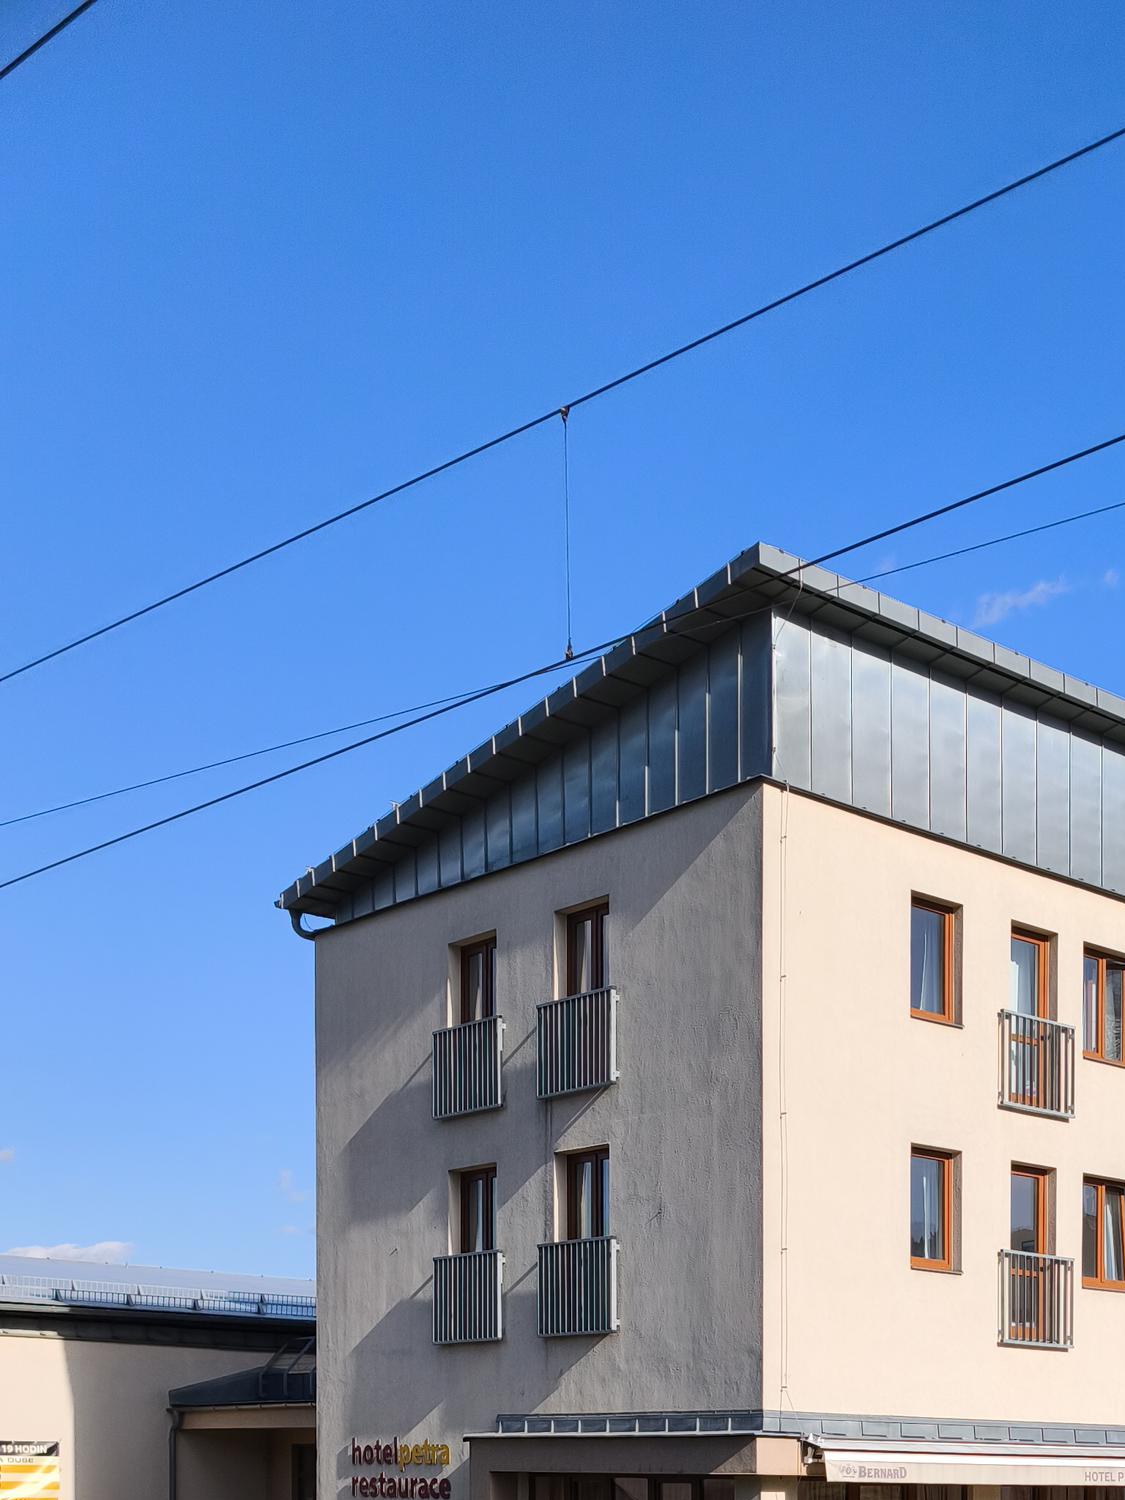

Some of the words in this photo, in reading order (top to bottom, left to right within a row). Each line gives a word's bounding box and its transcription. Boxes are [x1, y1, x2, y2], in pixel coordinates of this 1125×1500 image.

[2, 1445, 13, 1453] 19
[15, 1445, 47, 1453] HODIN
[858, 1465, 907, 1479] BERNARD
[1084, 1471, 1116, 1482] HOTEL
[351, 1471, 451, 1500] restaurace
